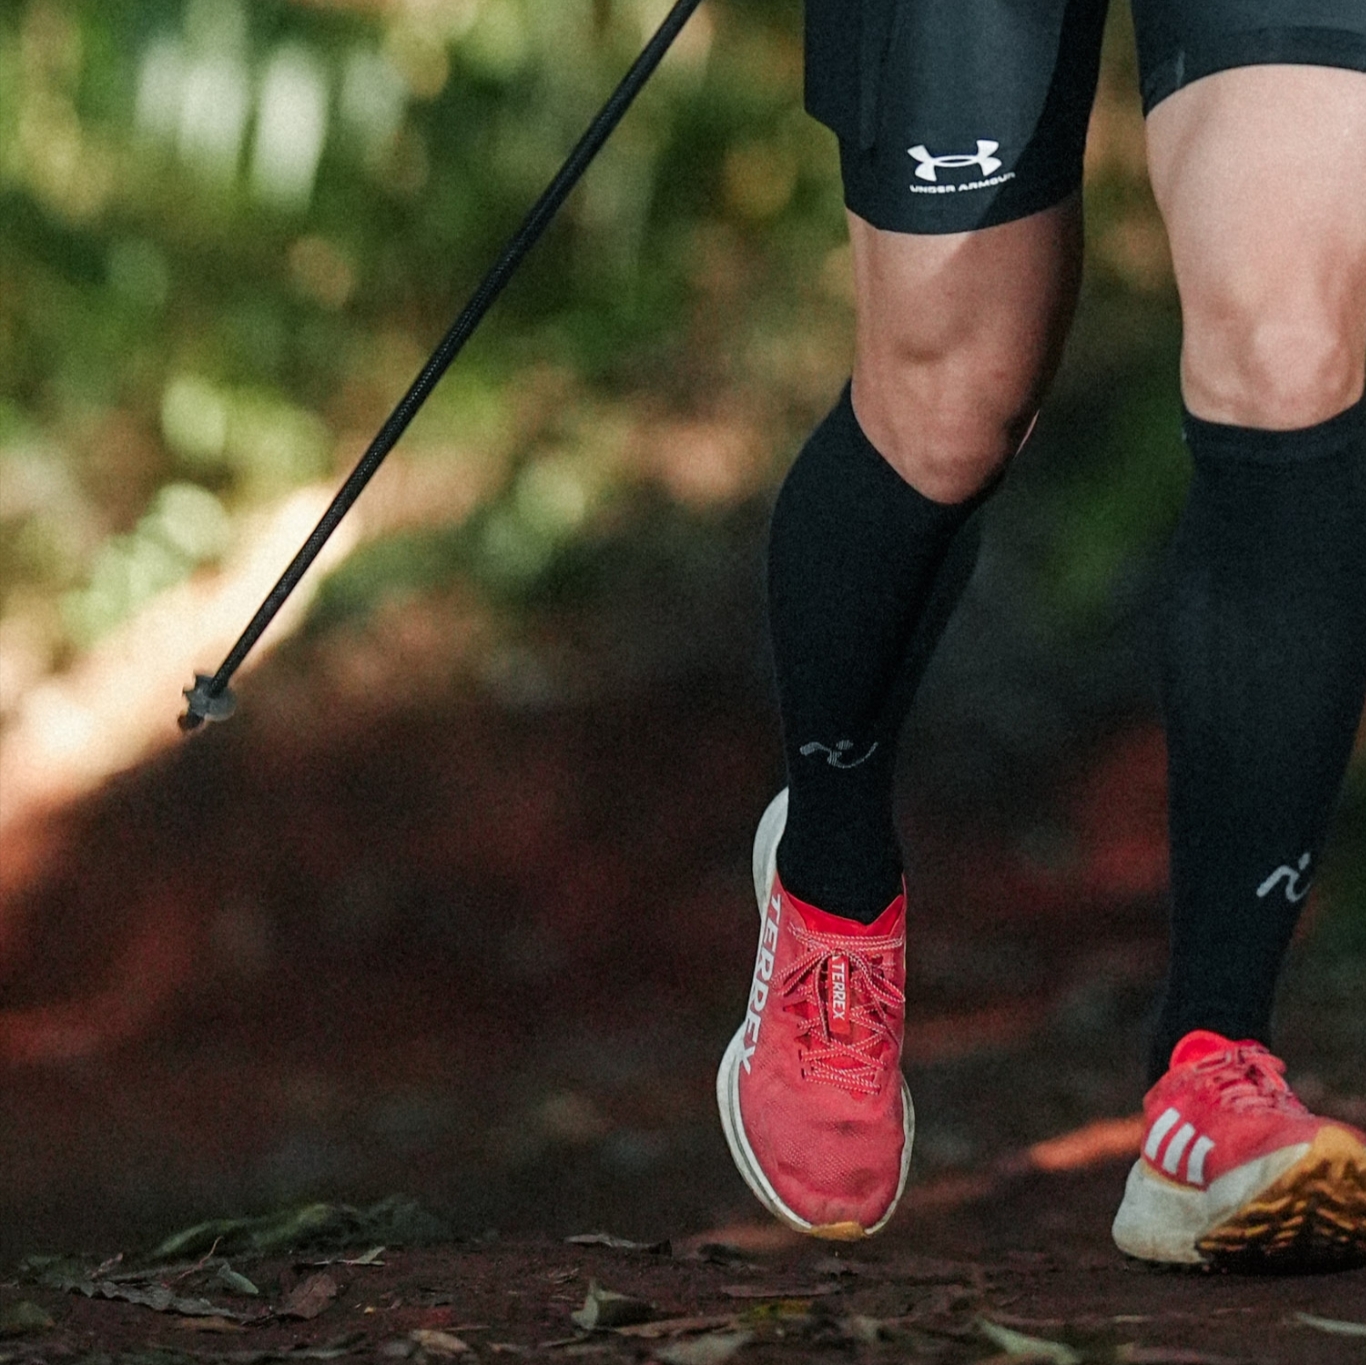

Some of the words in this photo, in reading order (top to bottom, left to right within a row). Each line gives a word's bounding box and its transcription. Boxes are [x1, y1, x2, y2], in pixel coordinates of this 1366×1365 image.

[909, 184, 956, 194] UNDER
[958, 172, 1016, 191] ARMOUR
[739, 893, 781, 1075] TERREX
[831, 962, 846, 1021] TERREX
